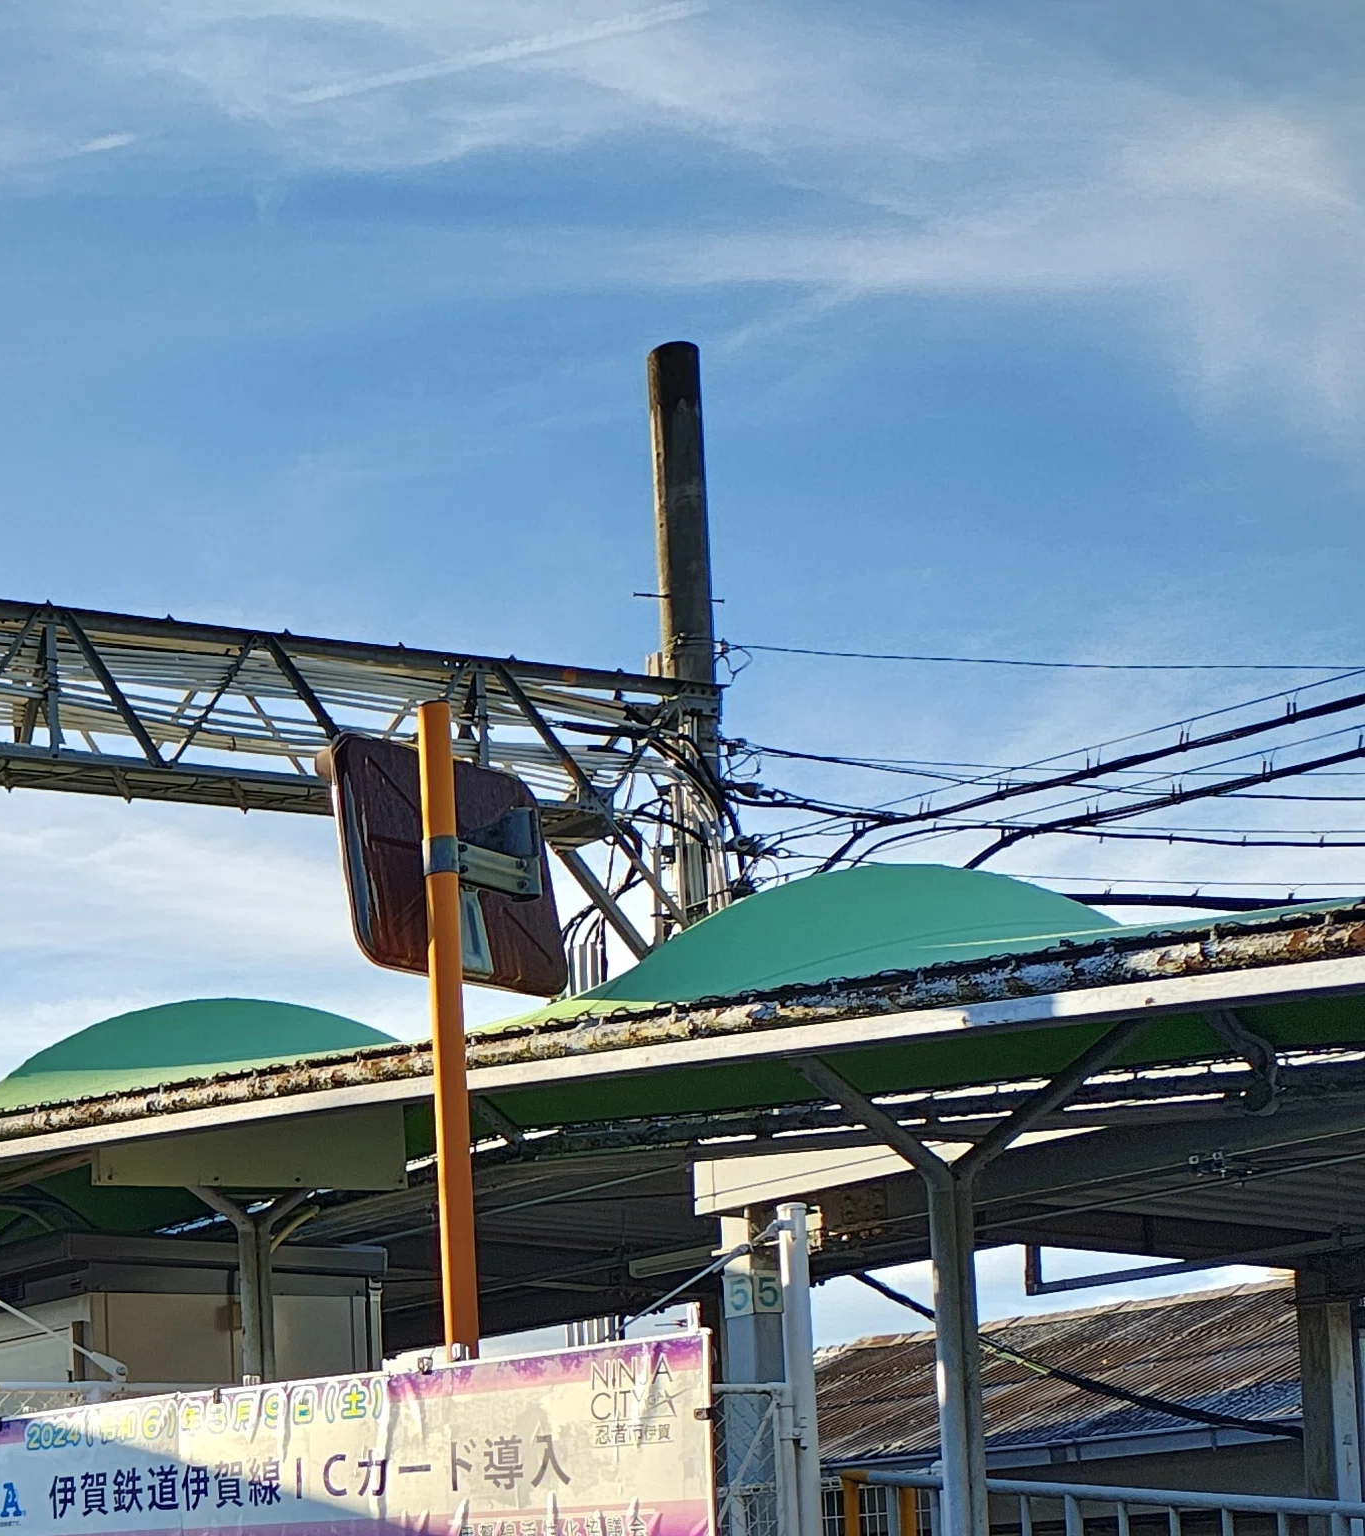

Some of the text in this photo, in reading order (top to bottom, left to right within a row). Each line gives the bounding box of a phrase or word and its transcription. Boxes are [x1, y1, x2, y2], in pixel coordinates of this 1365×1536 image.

[730, 1278, 748, 1311] 5
[758, 1276, 778, 1307] 5
[591, 1352, 674, 1390] NINJA
